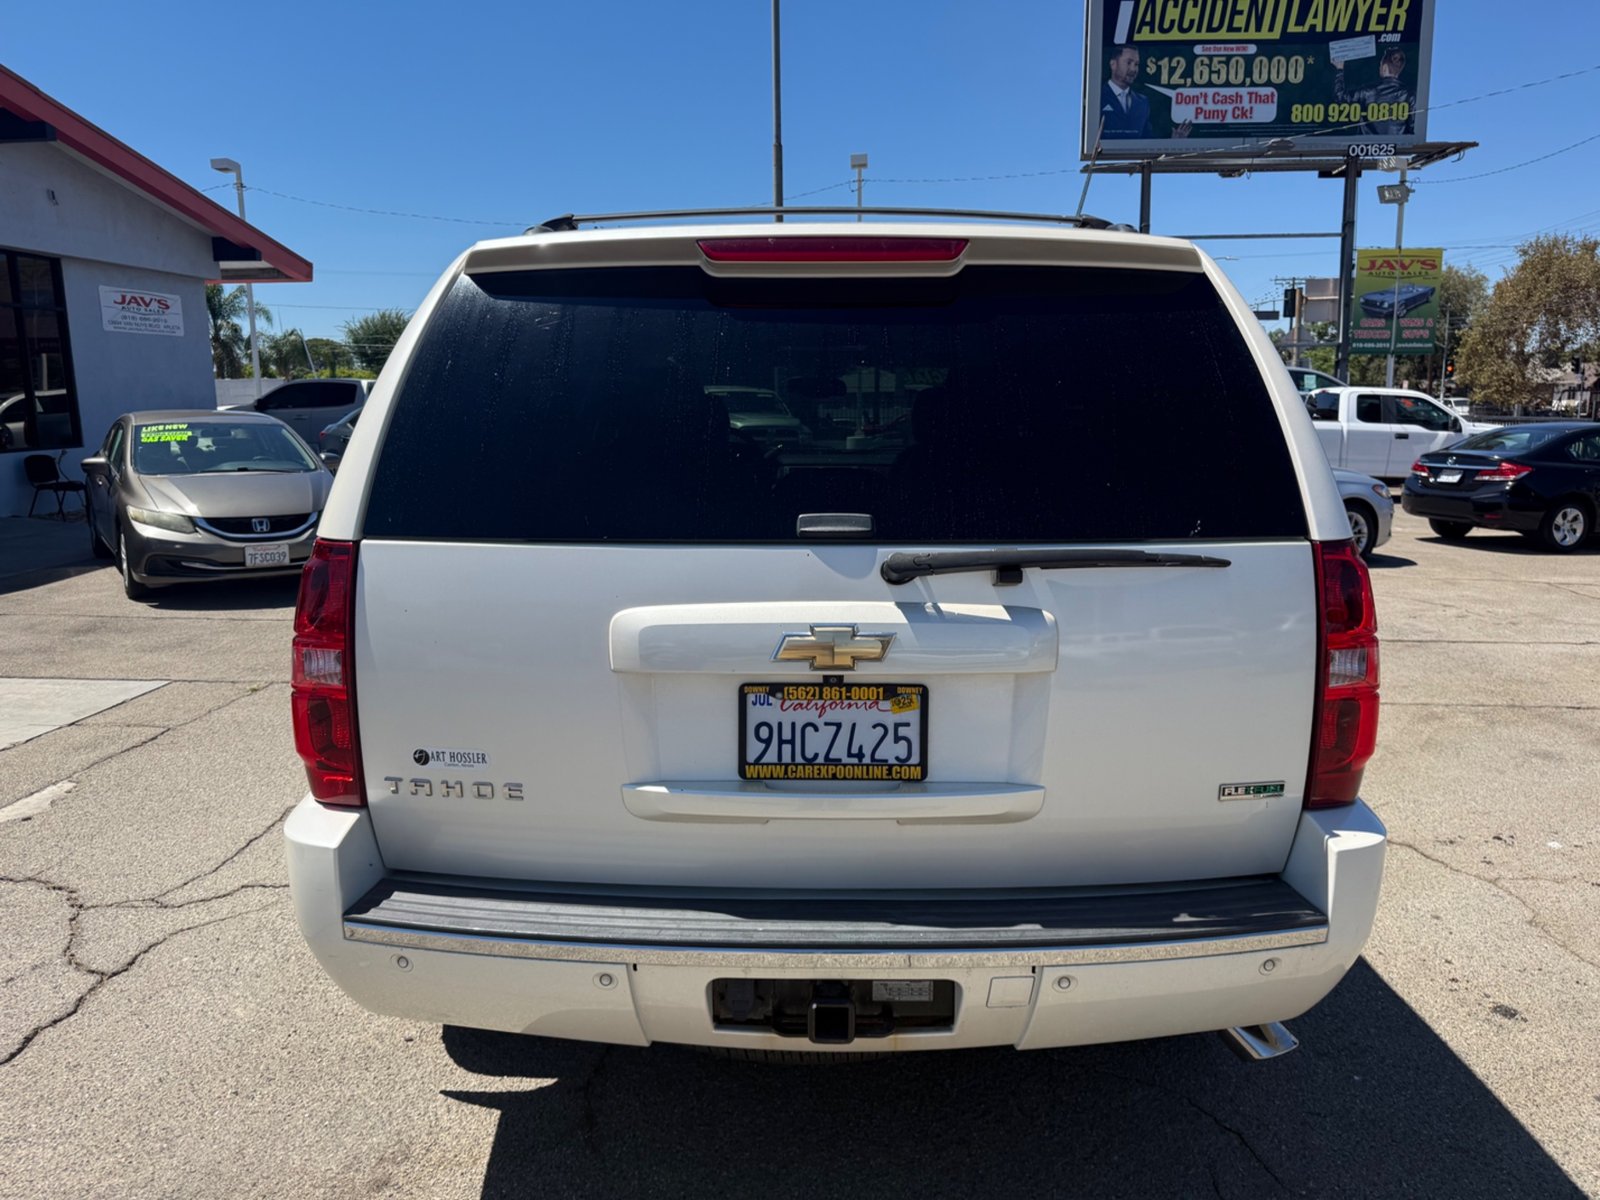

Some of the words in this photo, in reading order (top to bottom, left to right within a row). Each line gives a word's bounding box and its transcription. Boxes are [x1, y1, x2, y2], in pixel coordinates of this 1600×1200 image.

[1378, 33, 1401, 42] .com
[1175, 92, 1208, 105] Don't
[1212, 91, 1243, 104] Cash
[1248, 91, 1276, 104] That
[1195, 107, 1227, 121] Puny
[1232, 106, 1253, 120] Ck!
[1291, 104, 1325, 123] 800
[1328, 102, 1409, 122] 920-0810
[1349, 144, 1395, 156] 001625
[113, 294, 170, 310] JAV'S
[784, 686, 819, 700] (562)
[823, 686, 884, 700] 861-0001
[751, 694, 772, 706] JUL
[780, 698, 892, 719] California
[753, 721, 913, 764] 9HCZ425
[430, 751, 446, 762] ART
[449, 751, 487, 764] HOSSLER
[745, 764, 922, 780] WWW.CAREXPOONLINE.COM
[384, 776, 524, 801] TAHOE
